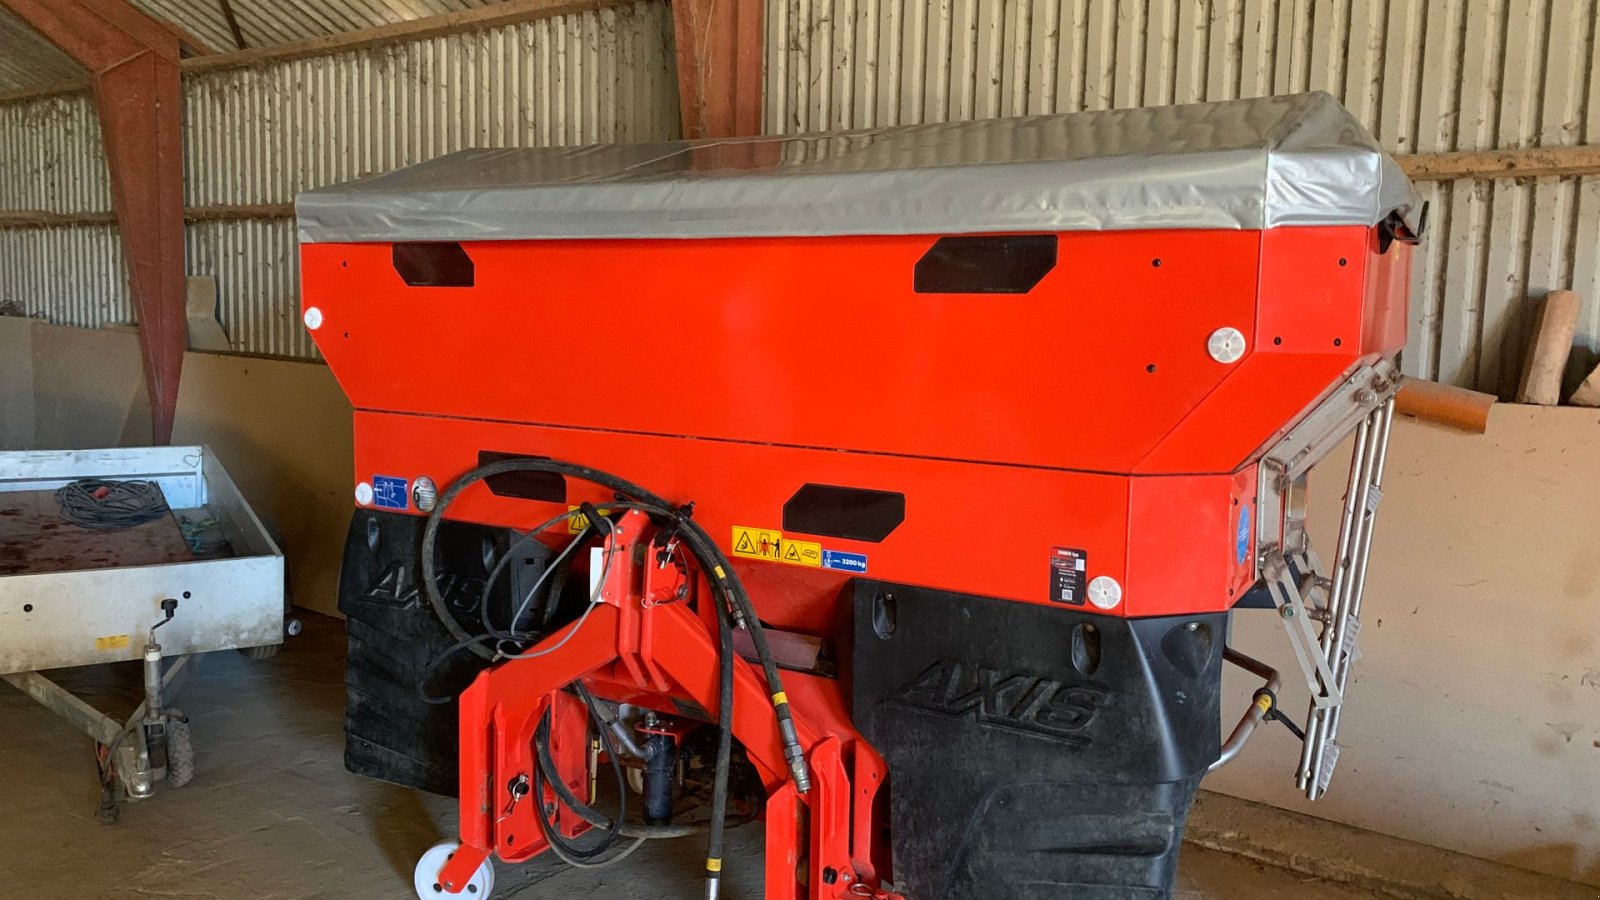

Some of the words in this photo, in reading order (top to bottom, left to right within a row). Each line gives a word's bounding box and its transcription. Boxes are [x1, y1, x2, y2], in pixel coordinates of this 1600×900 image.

[365, 563, 487, 612] AIS
[841, 558, 857, 566] 3200
[857, 560, 866, 568] kg
[895, 658, 1113, 732] AXIS
